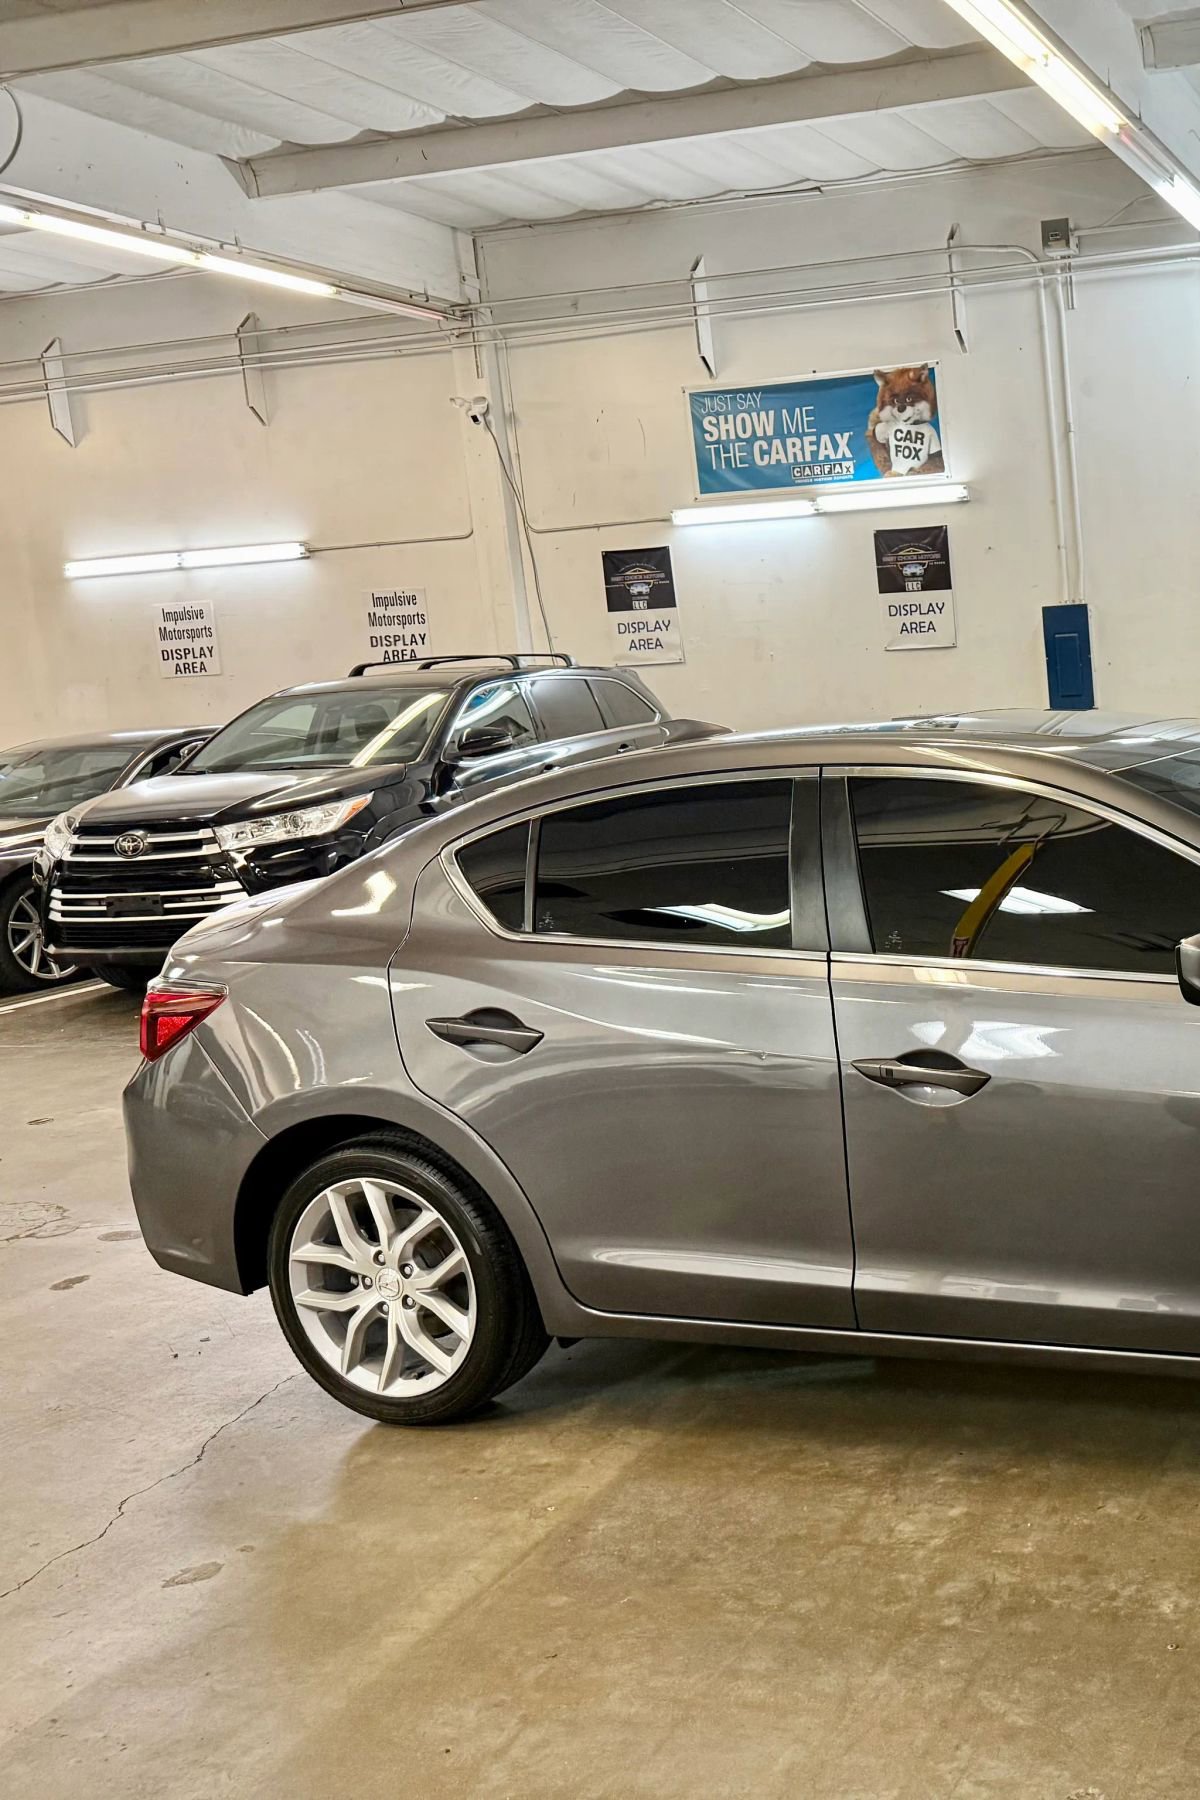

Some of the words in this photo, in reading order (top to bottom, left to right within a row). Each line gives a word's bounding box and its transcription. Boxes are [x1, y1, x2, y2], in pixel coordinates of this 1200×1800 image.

[701, 395, 734, 413] JUST
[736, 392, 762, 408] SAY
[702, 410, 775, 442] SHOW
[782, 406, 817, 434] ME
[894, 429, 925, 445] CAR
[705, 442, 749, 470] THE
[753, 432, 853, 466] CARFAX
[895, 445, 922, 462] FOX
[792, 462, 854, 478] CARFAX
[372, 591, 418, 611] Impulsive
[162, 606, 204, 626] Impulsive
[888, 602, 945, 617] DISPLAY
[368, 611, 426, 629] Motorsports
[617, 620, 671, 635] DISPLAY
[900, 621, 937, 635] AREA
[159, 625, 213, 643] Motorsports
[370, 633, 427, 648] DISPLAY
[629, 638, 664, 651] AREA
[161, 646, 214, 661] DISPLAY
[174, 661, 208, 675] AREA
